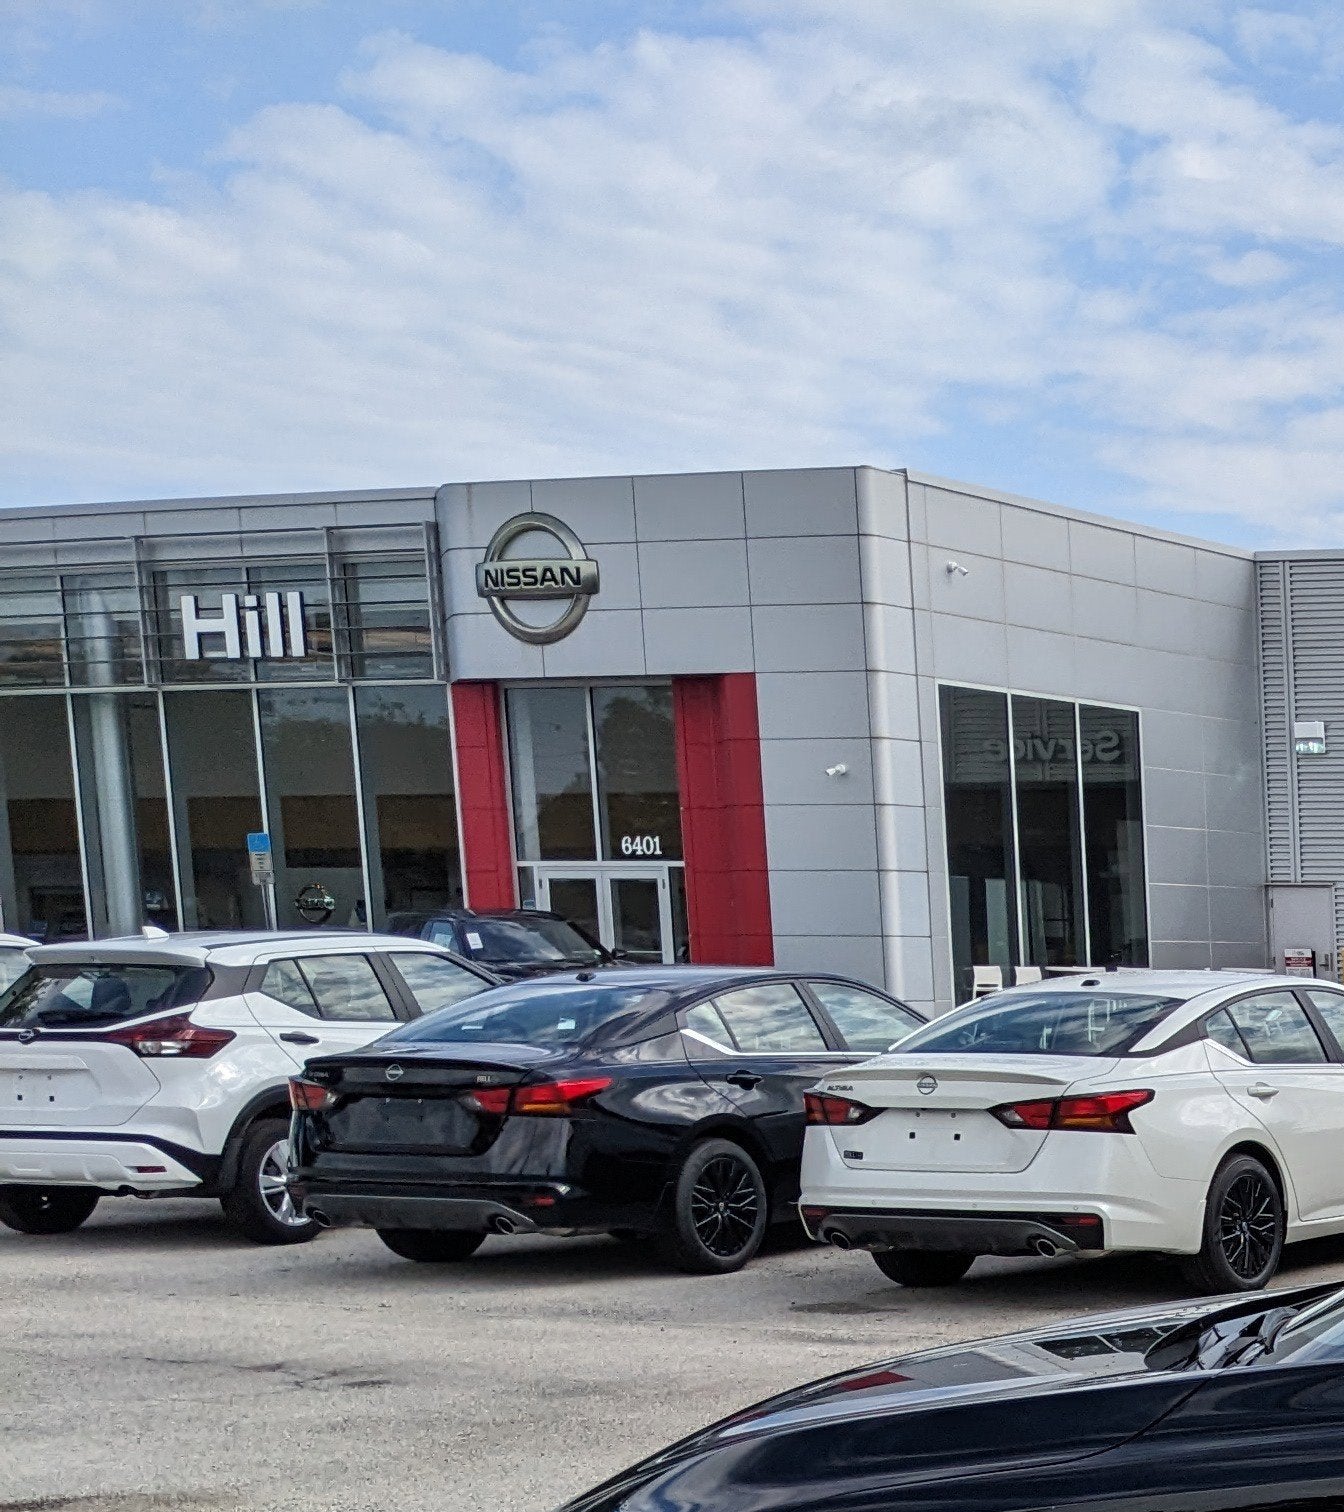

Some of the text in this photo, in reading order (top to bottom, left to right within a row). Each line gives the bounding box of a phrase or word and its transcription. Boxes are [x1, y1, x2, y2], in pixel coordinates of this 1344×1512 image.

[484, 565, 582, 589] NISSAN
[180, 591, 306, 660] Hill
[621, 835, 663, 856] 6401
